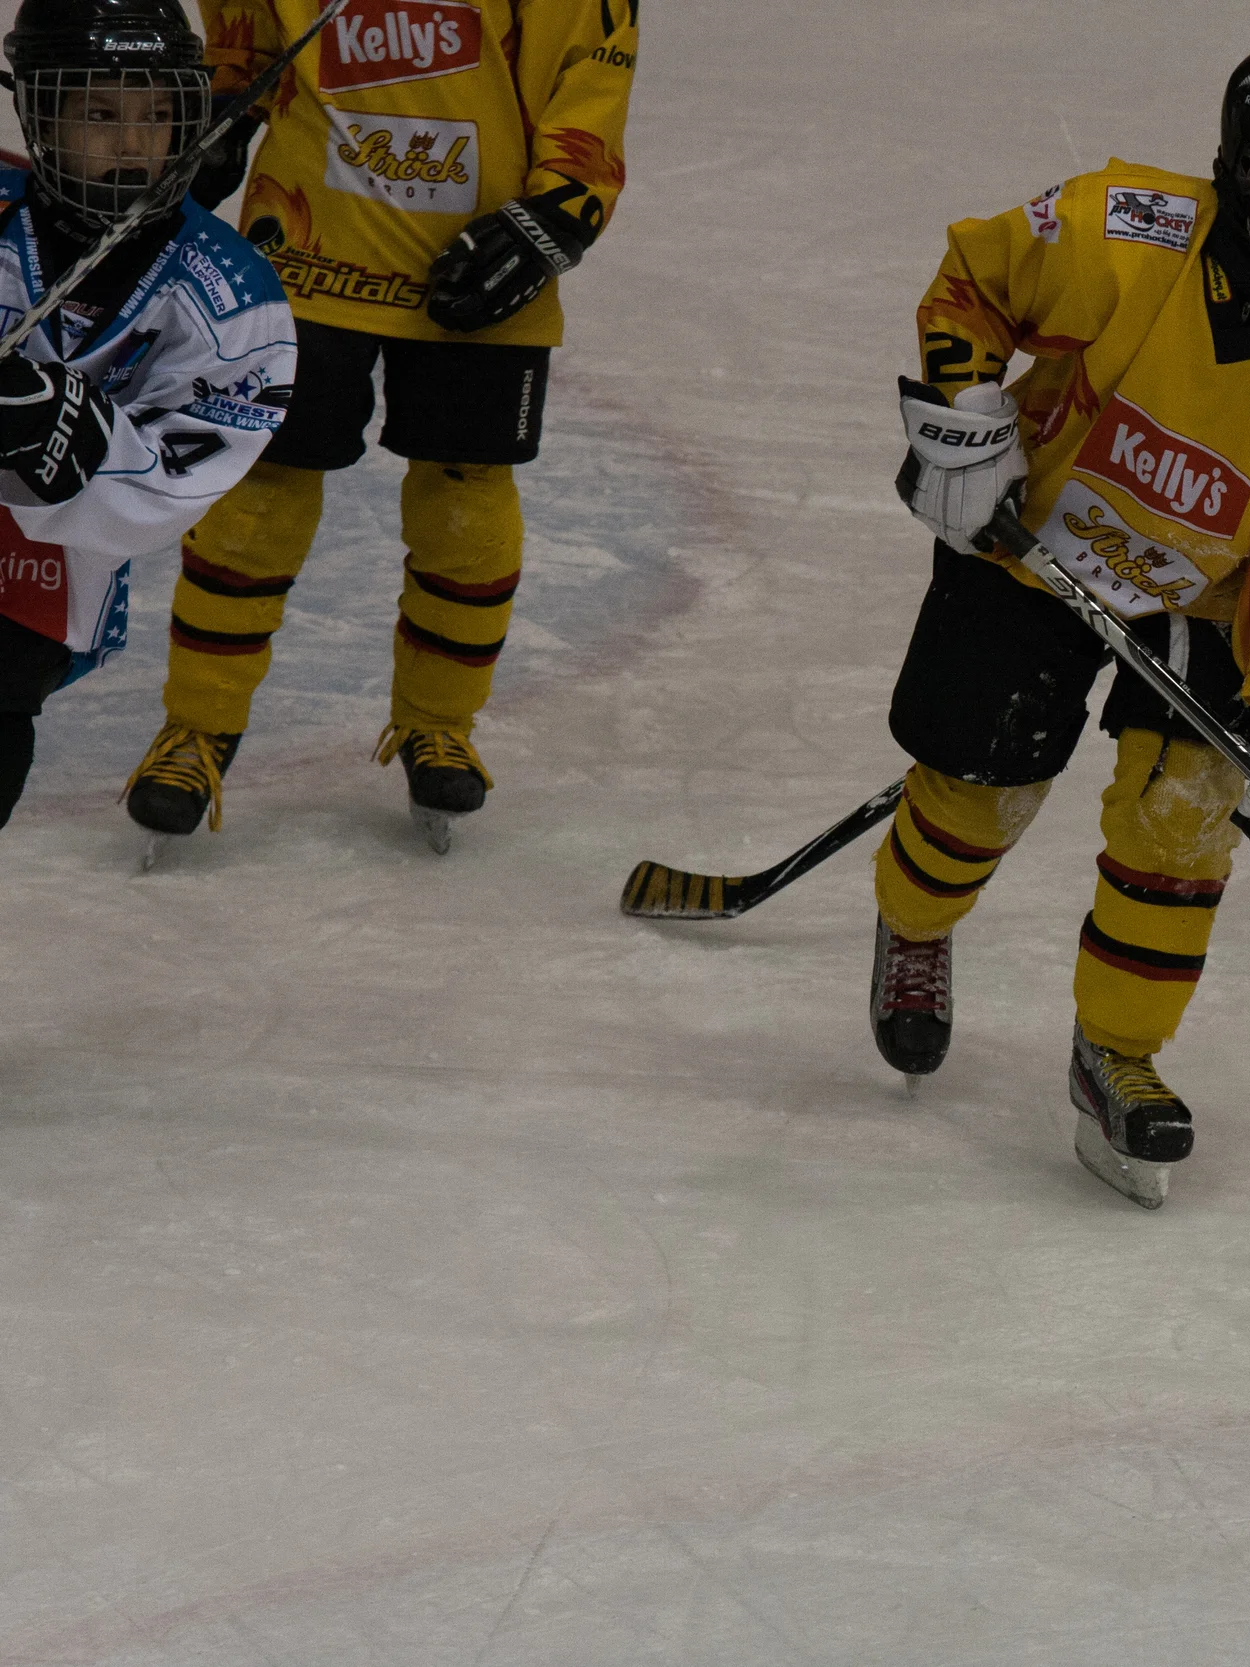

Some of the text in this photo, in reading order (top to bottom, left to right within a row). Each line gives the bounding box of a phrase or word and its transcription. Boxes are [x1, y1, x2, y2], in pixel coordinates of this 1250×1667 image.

[104, 42, 166, 54] BAUER
[336, 11, 462, 69] Kelly's
[338, 124, 471, 184] Ströck
[35, 366, 86, 486] BAUER
[189, 402, 234, 424] BLACK
[516, 369, 535, 442] Reebok
[1109, 423, 1228, 517] Kelly's
[1063, 505, 1197, 611] Ströck
[1076, 551, 1141, 604] BROT
